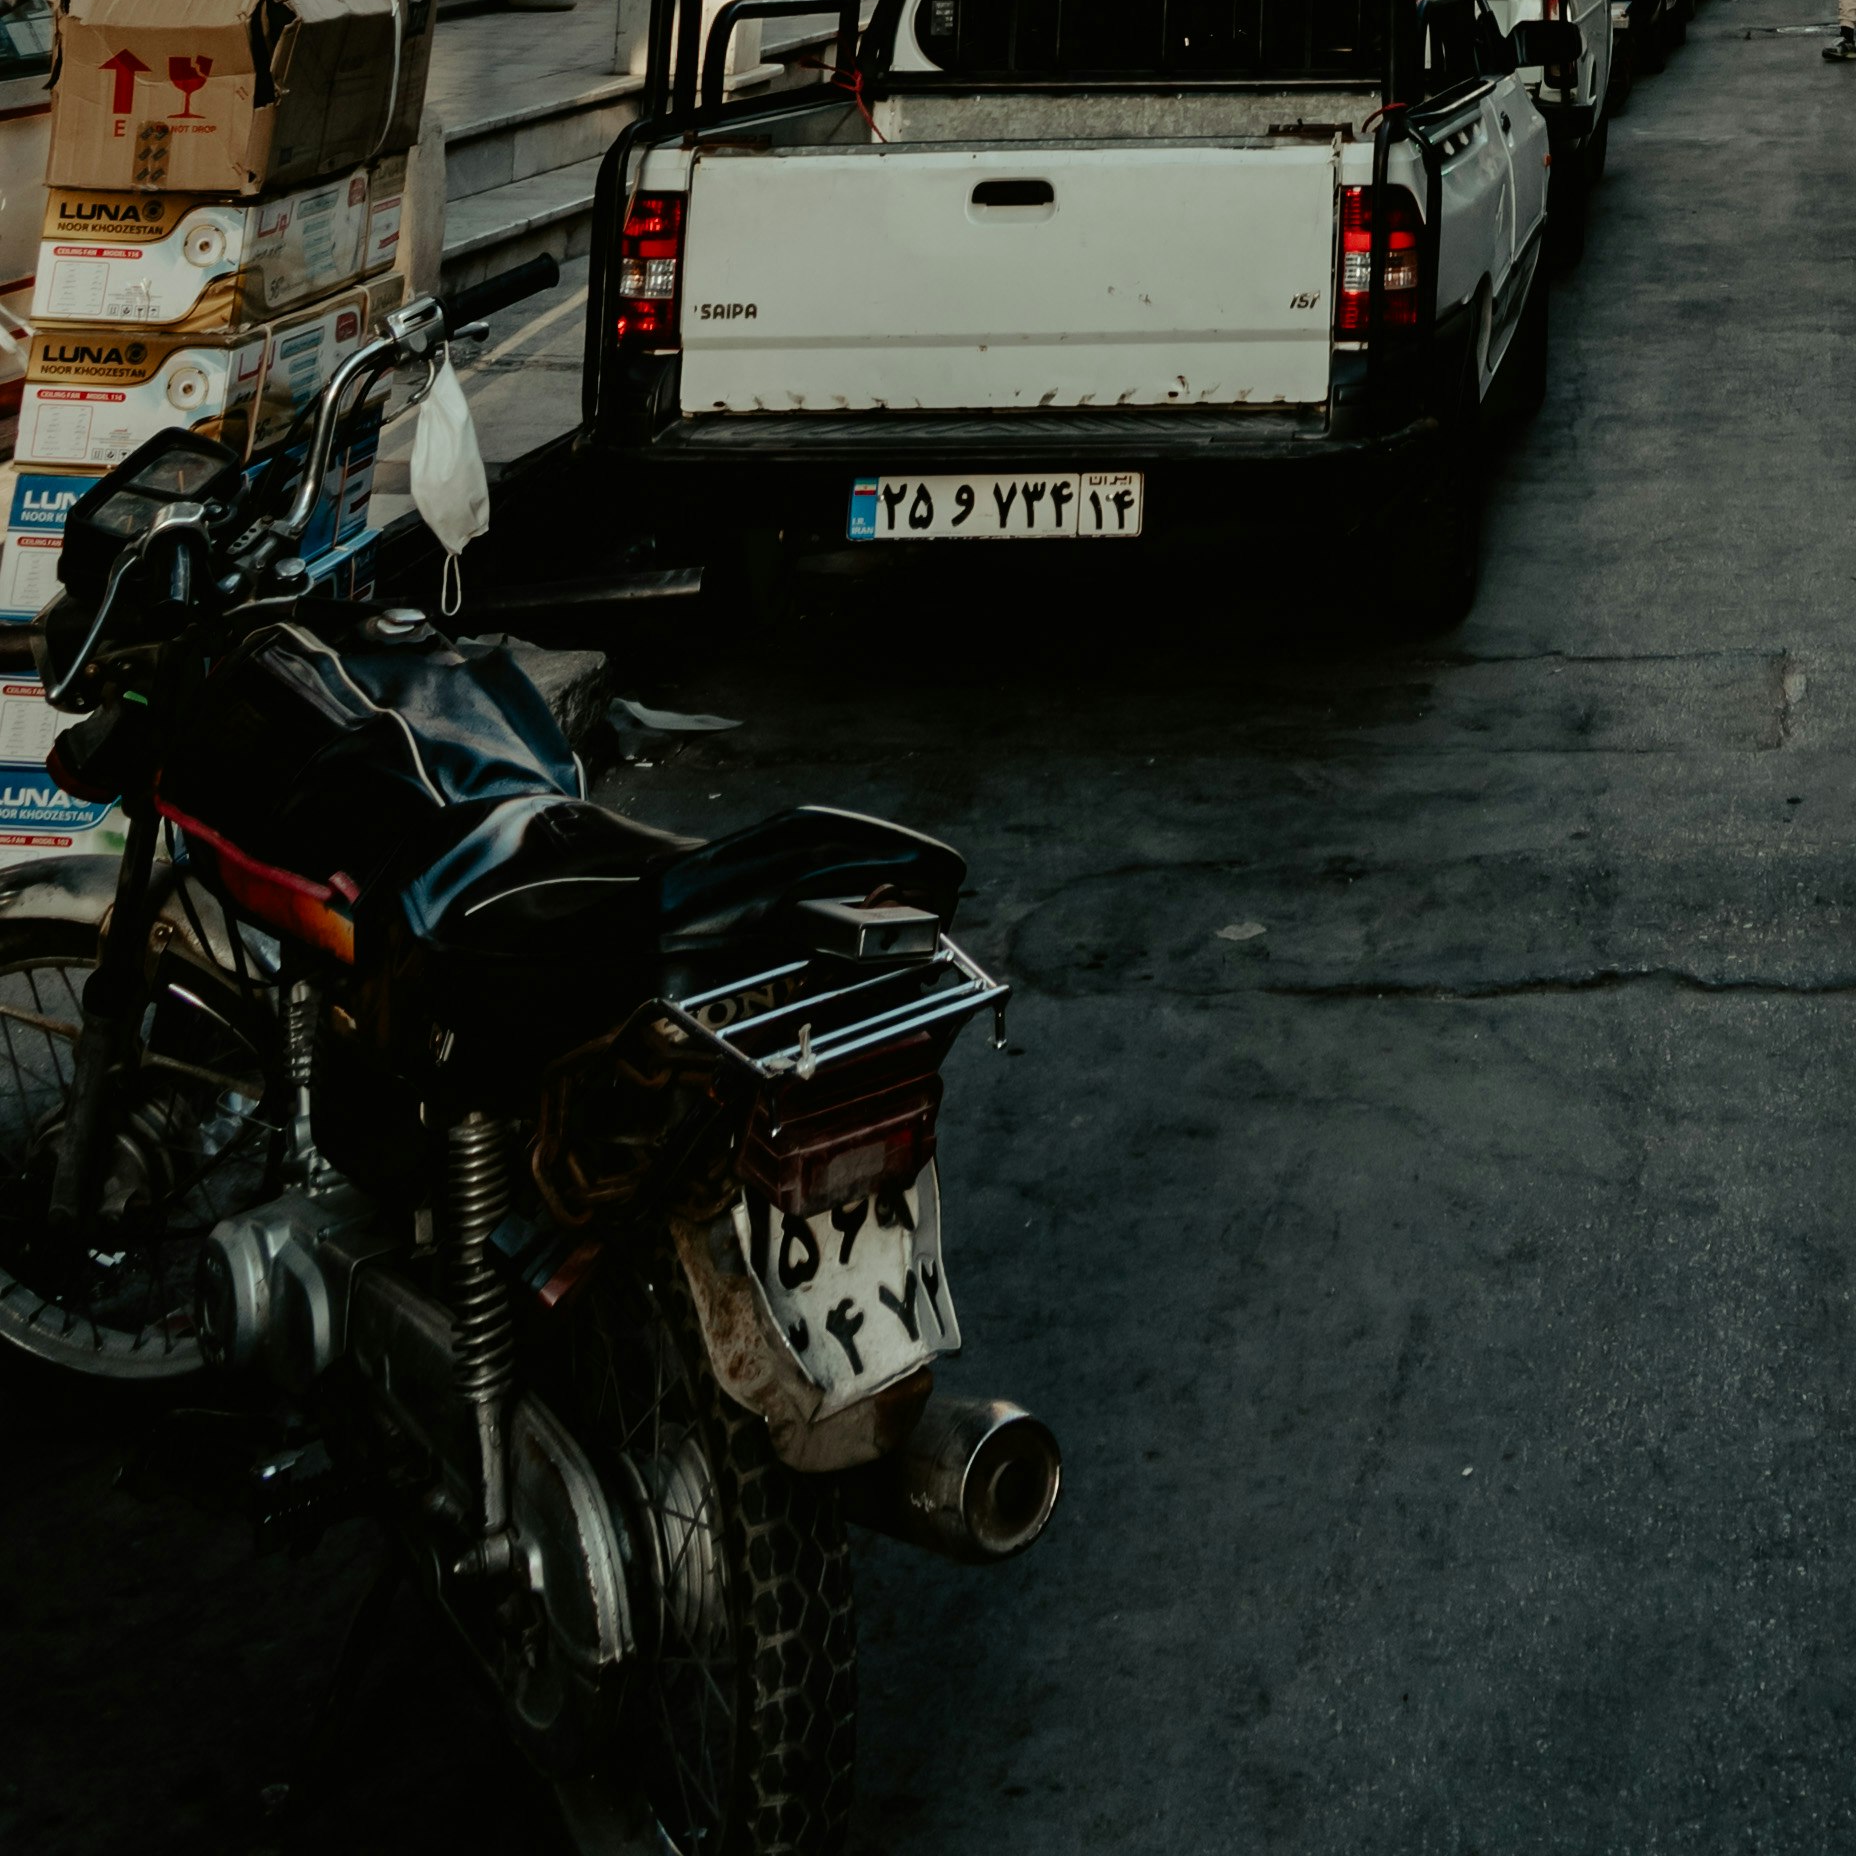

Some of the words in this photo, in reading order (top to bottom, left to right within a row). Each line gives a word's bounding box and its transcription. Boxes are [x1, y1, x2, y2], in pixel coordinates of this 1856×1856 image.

[114, 120, 126, 137] E
[192, 125, 217, 134] DROP
[59, 202, 141, 223] LUNA
[57, 222, 89, 232] NOOR
[91, 223, 163, 235] KHOOZESTAN
[700, 303, 757, 320] SAIPA
[42, 345, 123, 365] LUNA
[40, 365, 72, 375] NOOR
[74, 366, 146, 378] KHOOZESTAN
[23, 489, 87, 510] LUN
[882, 481, 934, 531] ۲۵
[951, 484, 976, 527] و
[993, 481, 1073, 529] ۷۳۴
[21, 510, 54, 522] NOOR
[1090, 490, 1135, 530] ۱۴
[851, 525, 874, 536] IRAN
[21, 538, 47, 546] CEILING
[5, 687, 33, 696] CEILING
[19, 809, 94, 822] KHOOZESTAN
